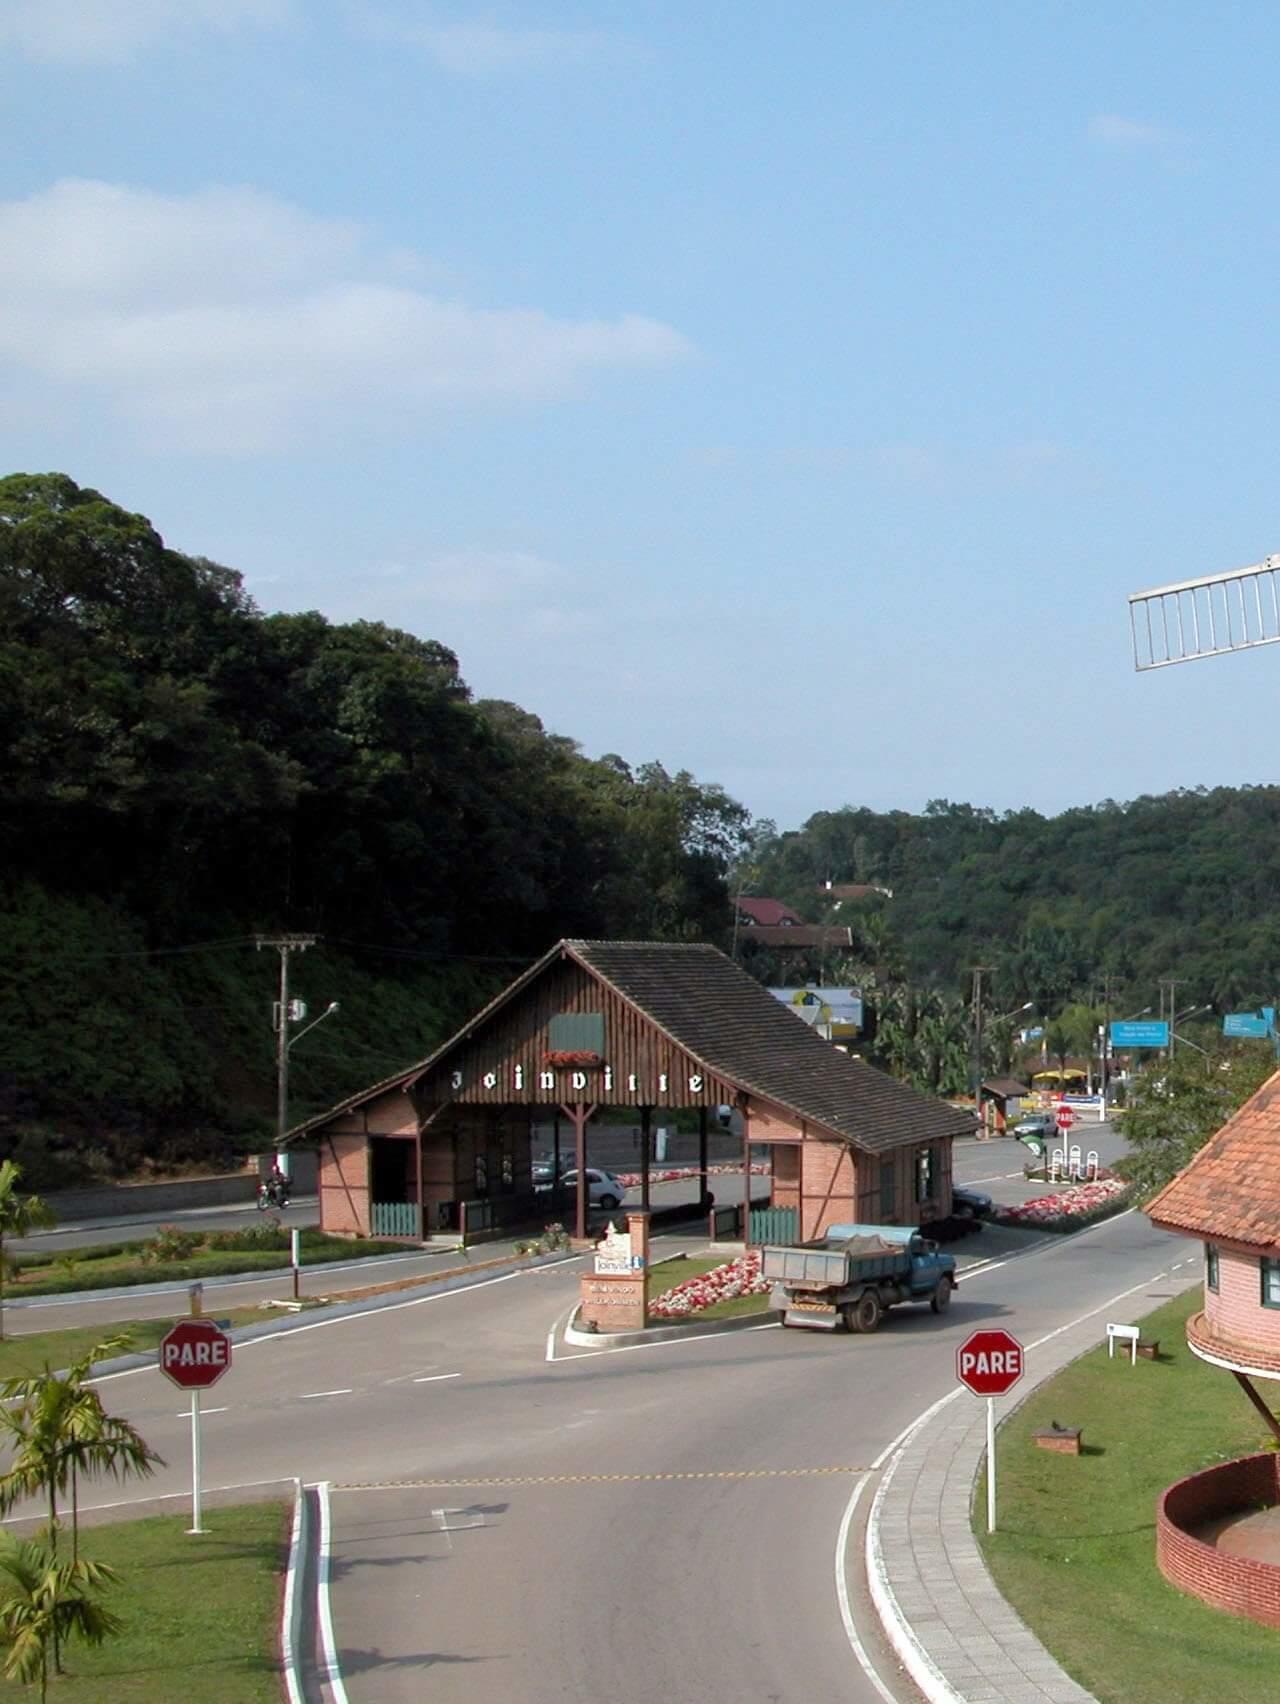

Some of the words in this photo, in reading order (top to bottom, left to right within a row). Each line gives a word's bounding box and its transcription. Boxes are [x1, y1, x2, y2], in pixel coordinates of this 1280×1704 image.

[451, 1064, 705, 1092] Joinville
[165, 1341, 226, 1367] PARE
[962, 1350, 1019, 1375] PARE
